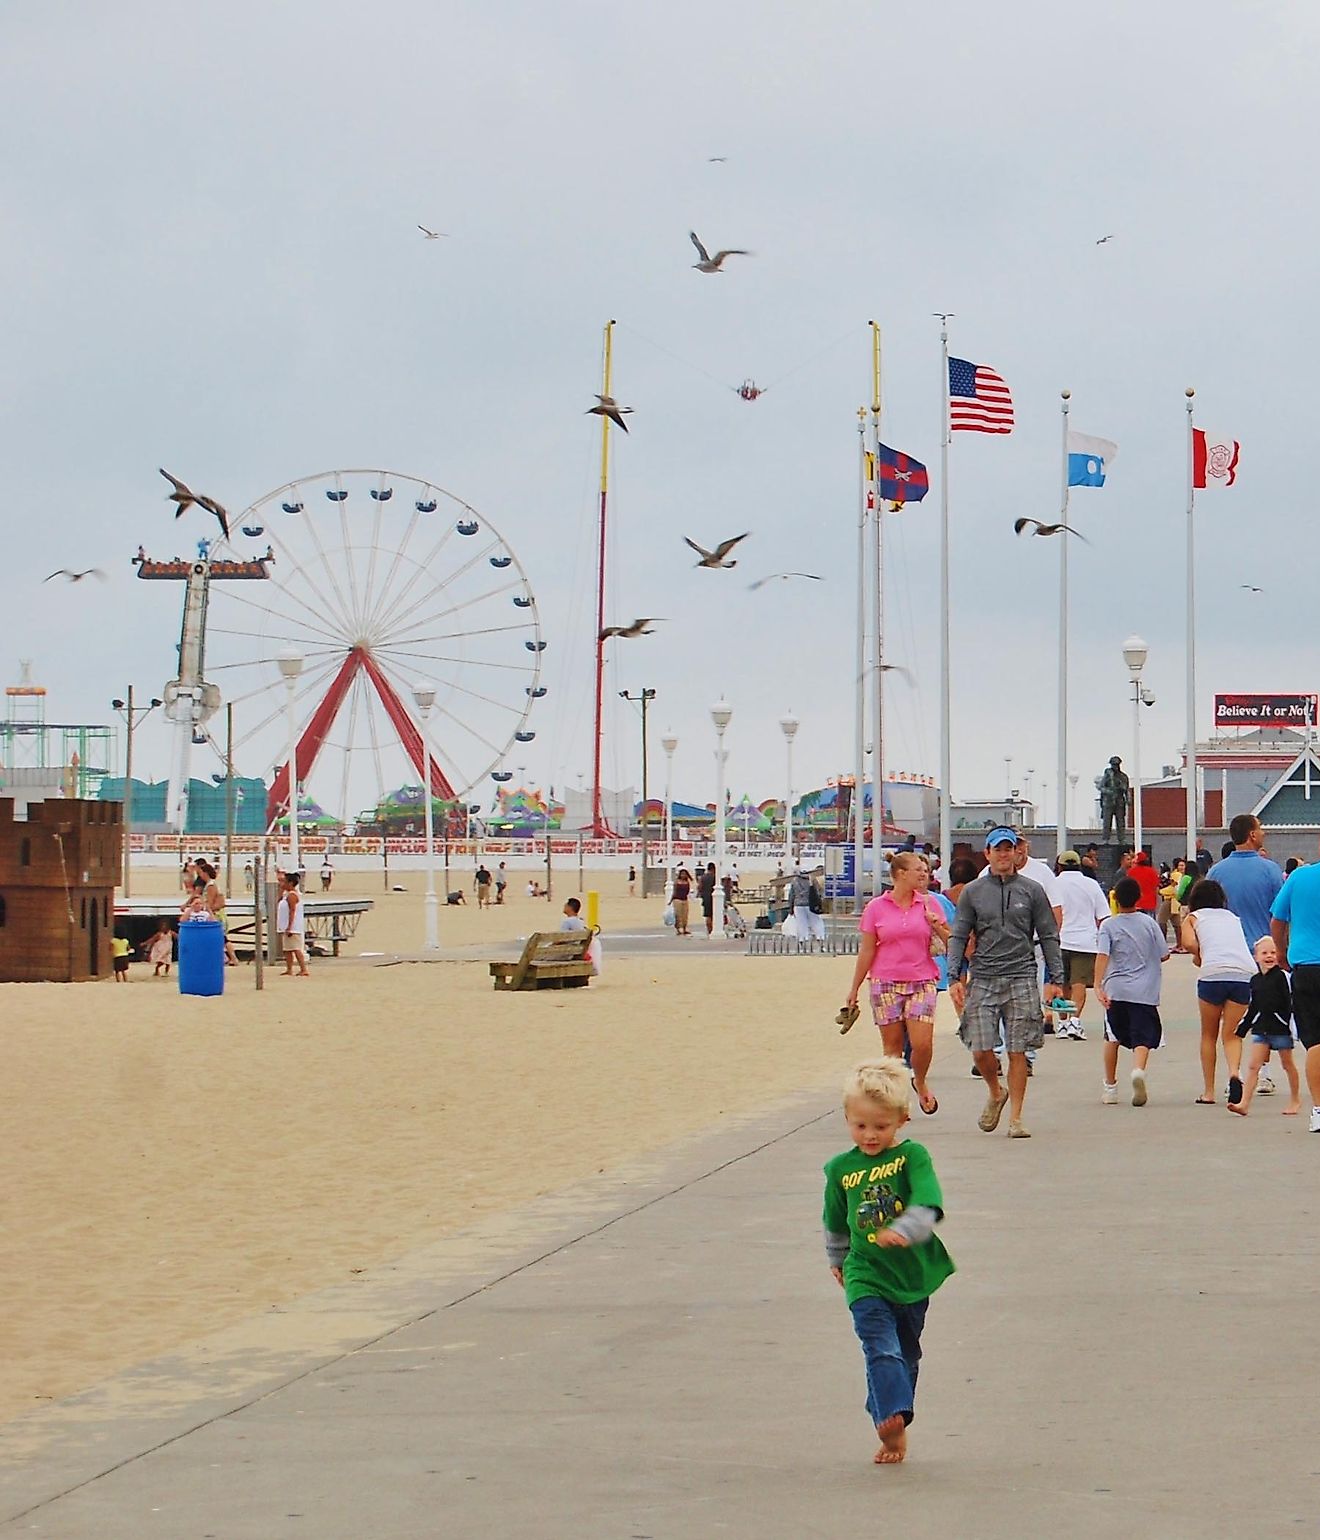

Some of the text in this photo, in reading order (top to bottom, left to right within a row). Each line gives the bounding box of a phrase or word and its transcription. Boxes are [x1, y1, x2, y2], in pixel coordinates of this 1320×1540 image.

[1217, 705, 1314, 716] Believe It or Not!
[842, 1169, 867, 1190] GOT
